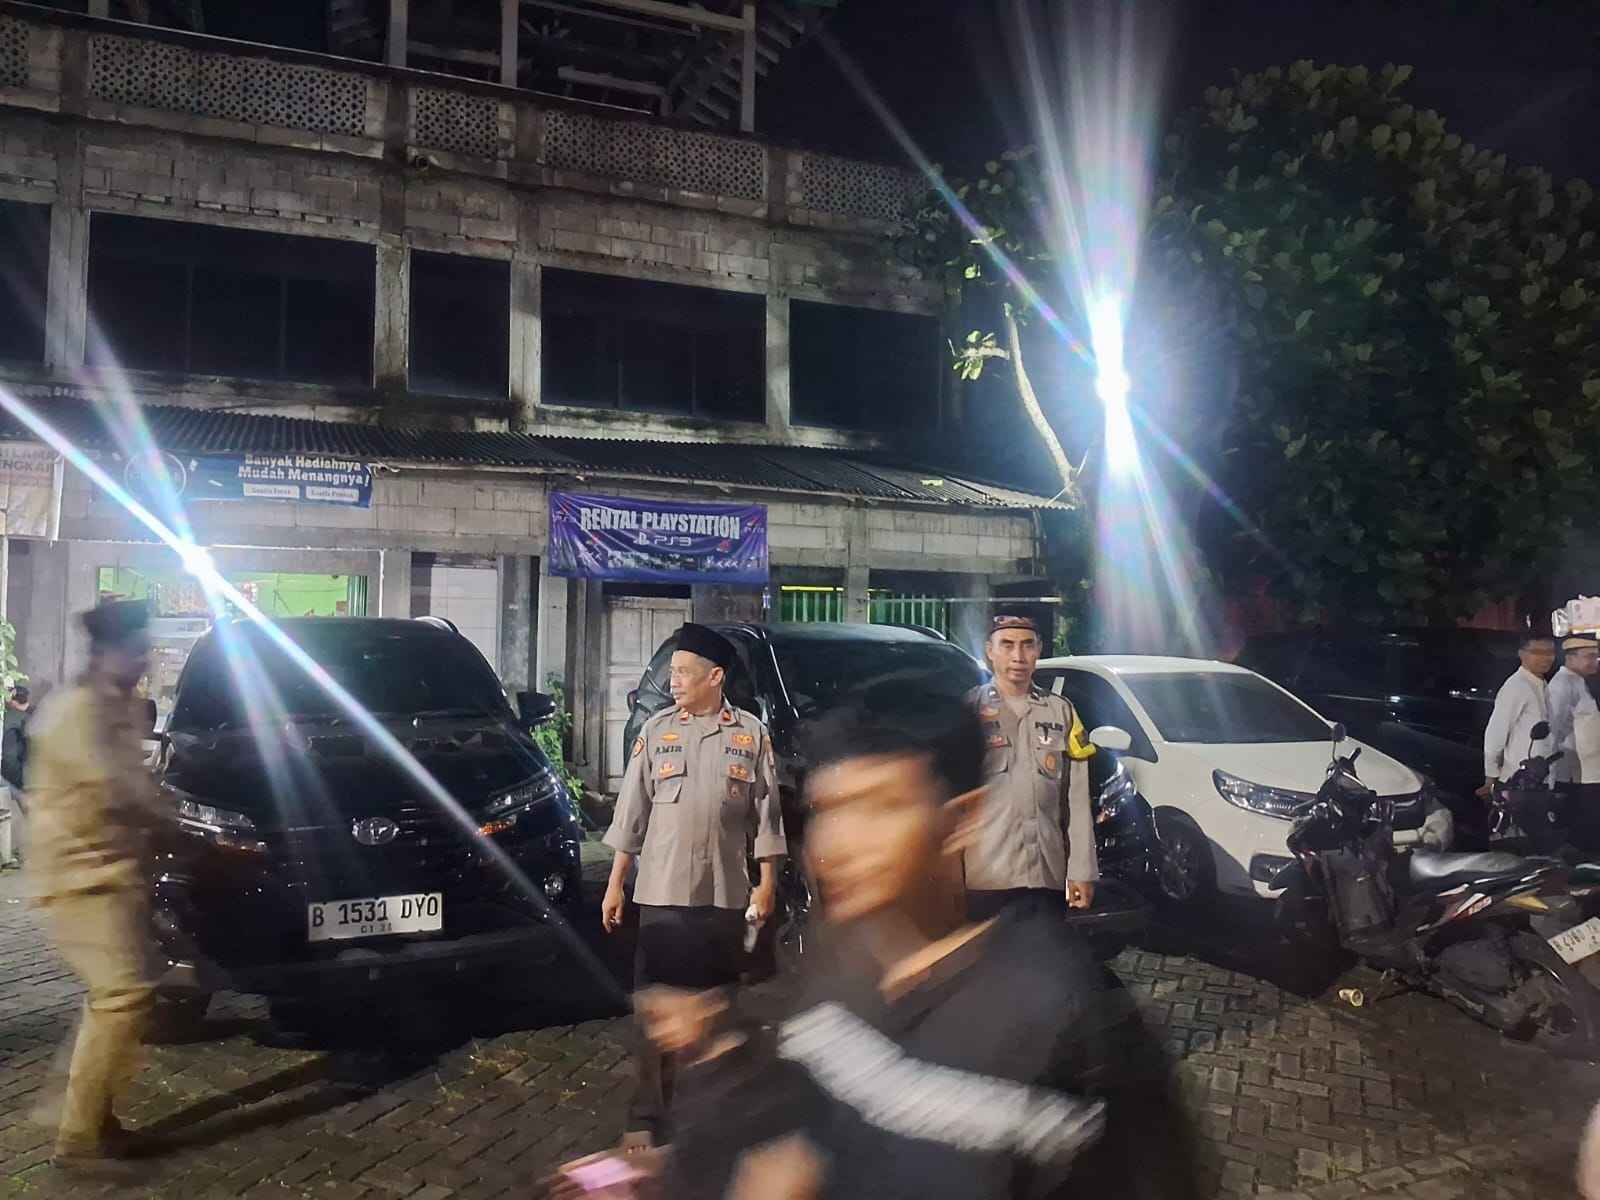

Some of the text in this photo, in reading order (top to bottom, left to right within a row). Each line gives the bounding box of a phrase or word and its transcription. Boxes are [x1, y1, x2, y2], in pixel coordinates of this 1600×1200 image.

[245, 454, 361, 472] Banyak Hadiahnya
[238, 466, 370, 487] Mudah Menangnya!
[580, 507, 640, 531] RENTAL
[641, 511, 740, 540] PLAYSTATION
[653, 535, 692, 547] PS3
[656, 745, 683, 755] AMIR
[312, 896, 439, 927] B 1531 DYO
